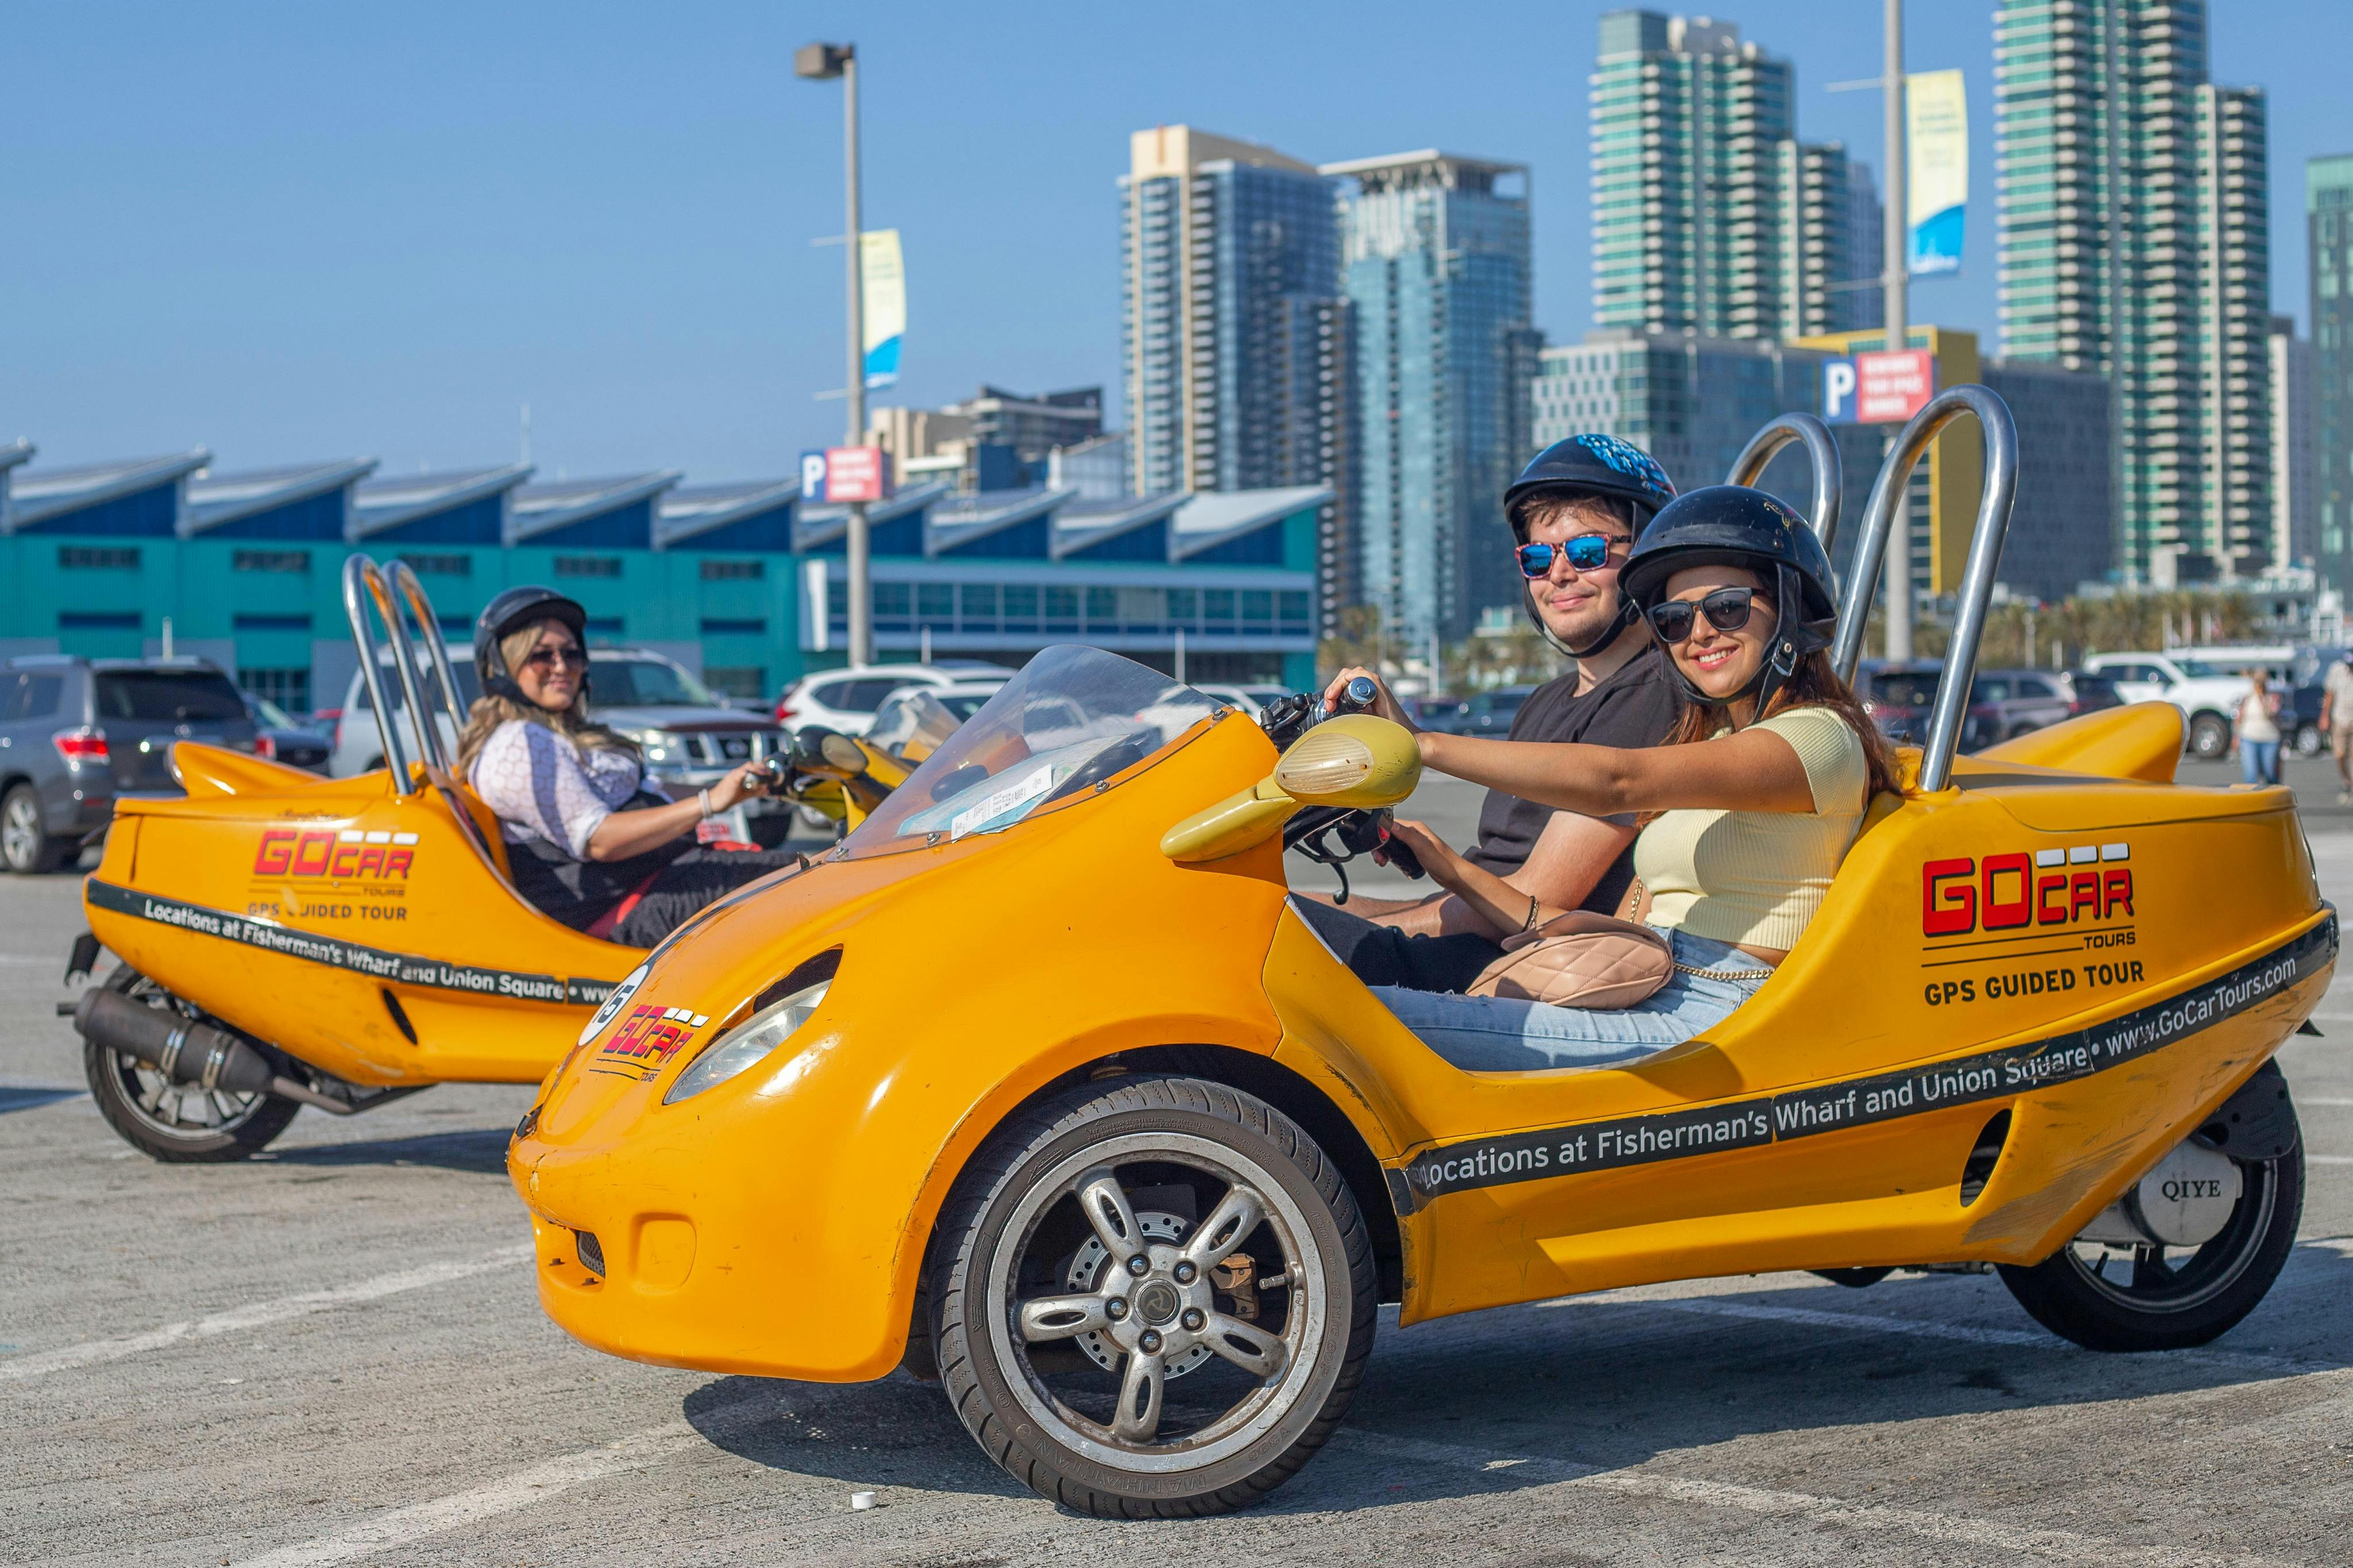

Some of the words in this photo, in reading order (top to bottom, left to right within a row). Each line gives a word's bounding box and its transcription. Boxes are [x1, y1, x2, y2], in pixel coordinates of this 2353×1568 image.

[1826, 362, 1856, 417] P
[803, 454, 826, 498] P
[248, 902, 280, 916] GPS
[360, 904, 407, 920] TOUR
[1922, 851, 2134, 938] GOCAR
[144, 899, 221, 934] Locations
[222, 920, 241, 939] at
[242, 921, 343, 964] Fisherman's
[346, 949, 402, 976] Wharf
[401, 965, 436, 983] and
[440, 966, 495, 991] Union
[498, 975, 565, 999] Square
[2084, 932, 2136, 949] TOURS
[1924, 979, 1976, 1006] GPS
[1985, 968, 2076, 999] GUIDED
[2084, 960, 2144, 987] TOUR
[1423, 1148, 1549, 1190] Locations
[1559, 1134, 1587, 1164] at
[1598, 1111, 1768, 1159] Fisherman's
[1775, 1090, 1856, 1131] Wharf
[1865, 1079, 1913, 1114] and
[1922, 1067, 1997, 1101] Union
[2005, 1046, 2087, 1086] Square
[2105, 957, 2296, 1057] www.GoCarTours.com
[2162, 1180, 2221, 1202] QIYE
